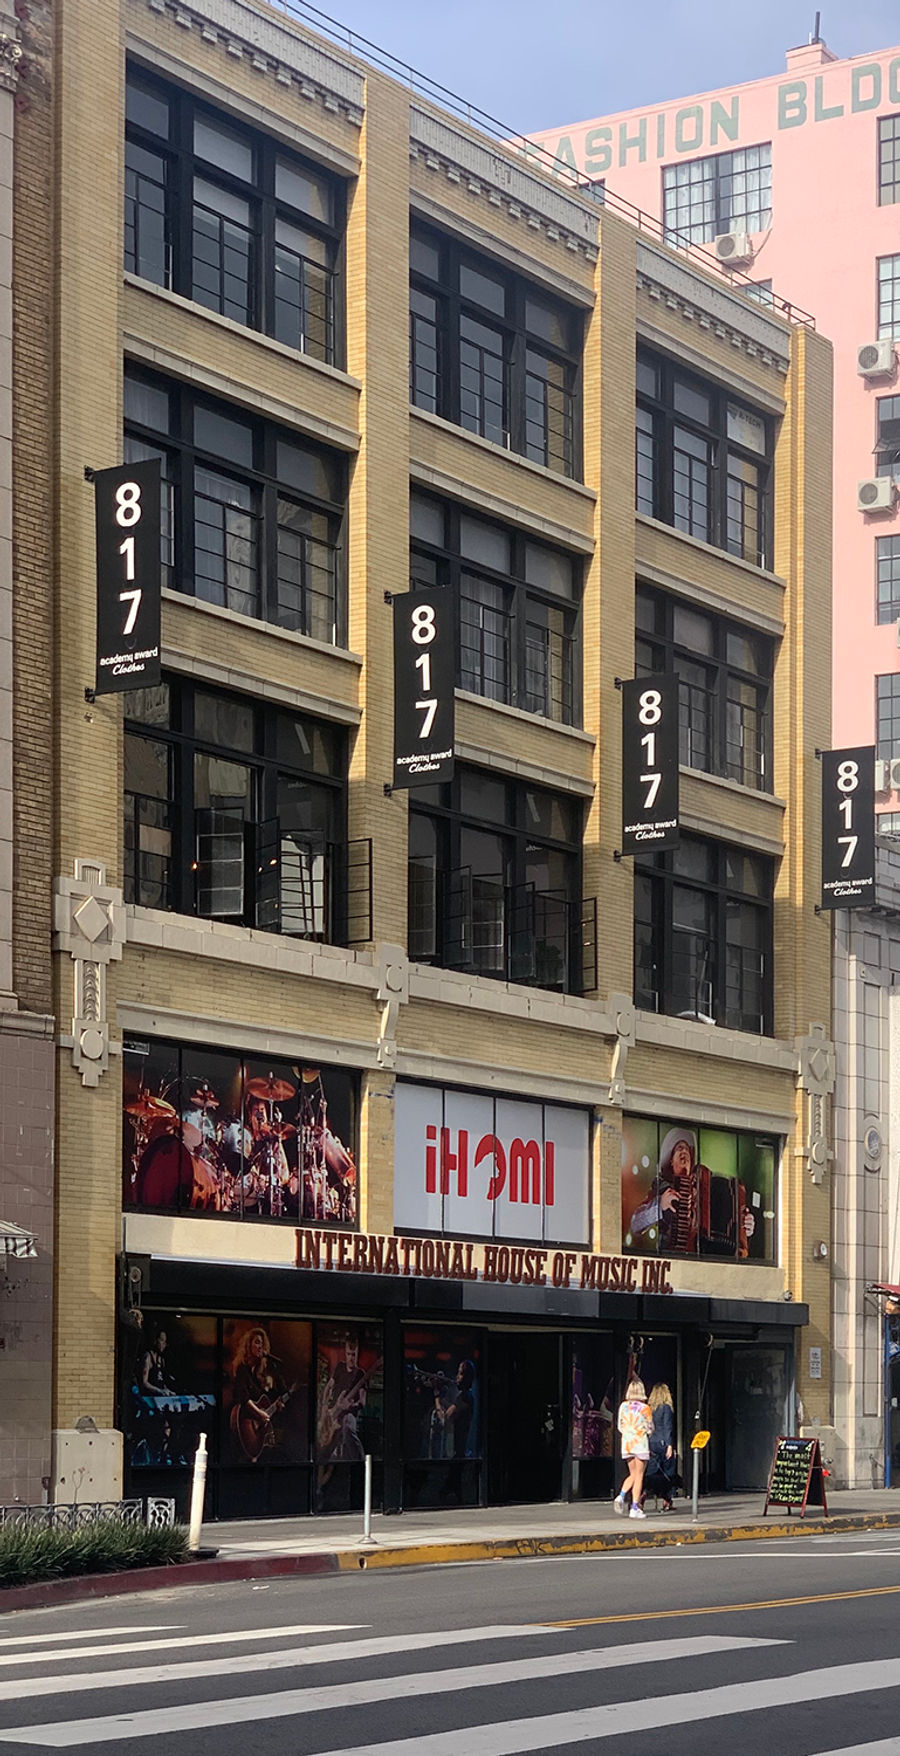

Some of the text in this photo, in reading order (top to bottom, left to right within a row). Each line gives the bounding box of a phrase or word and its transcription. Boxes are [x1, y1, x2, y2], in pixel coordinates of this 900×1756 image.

[115, 482, 142, 635] 817
[100, 646, 158, 666] academy award
[112, 662, 145, 676] Clothes
[411, 604, 438, 739] 817
[396, 748, 453, 765] academy award
[638, 690, 662, 809] 817
[408, 762, 440, 774] Clothes
[836, 760, 859, 868] 817
[624, 818, 677, 833] academy award
[635, 830, 665, 841] Clothes
[823, 877, 873, 890] academy award
[833, 887, 862, 897] Clothes
[295, 1228, 674, 1295] INTERNATIONAL HOUSE OF MUSIC INC.
